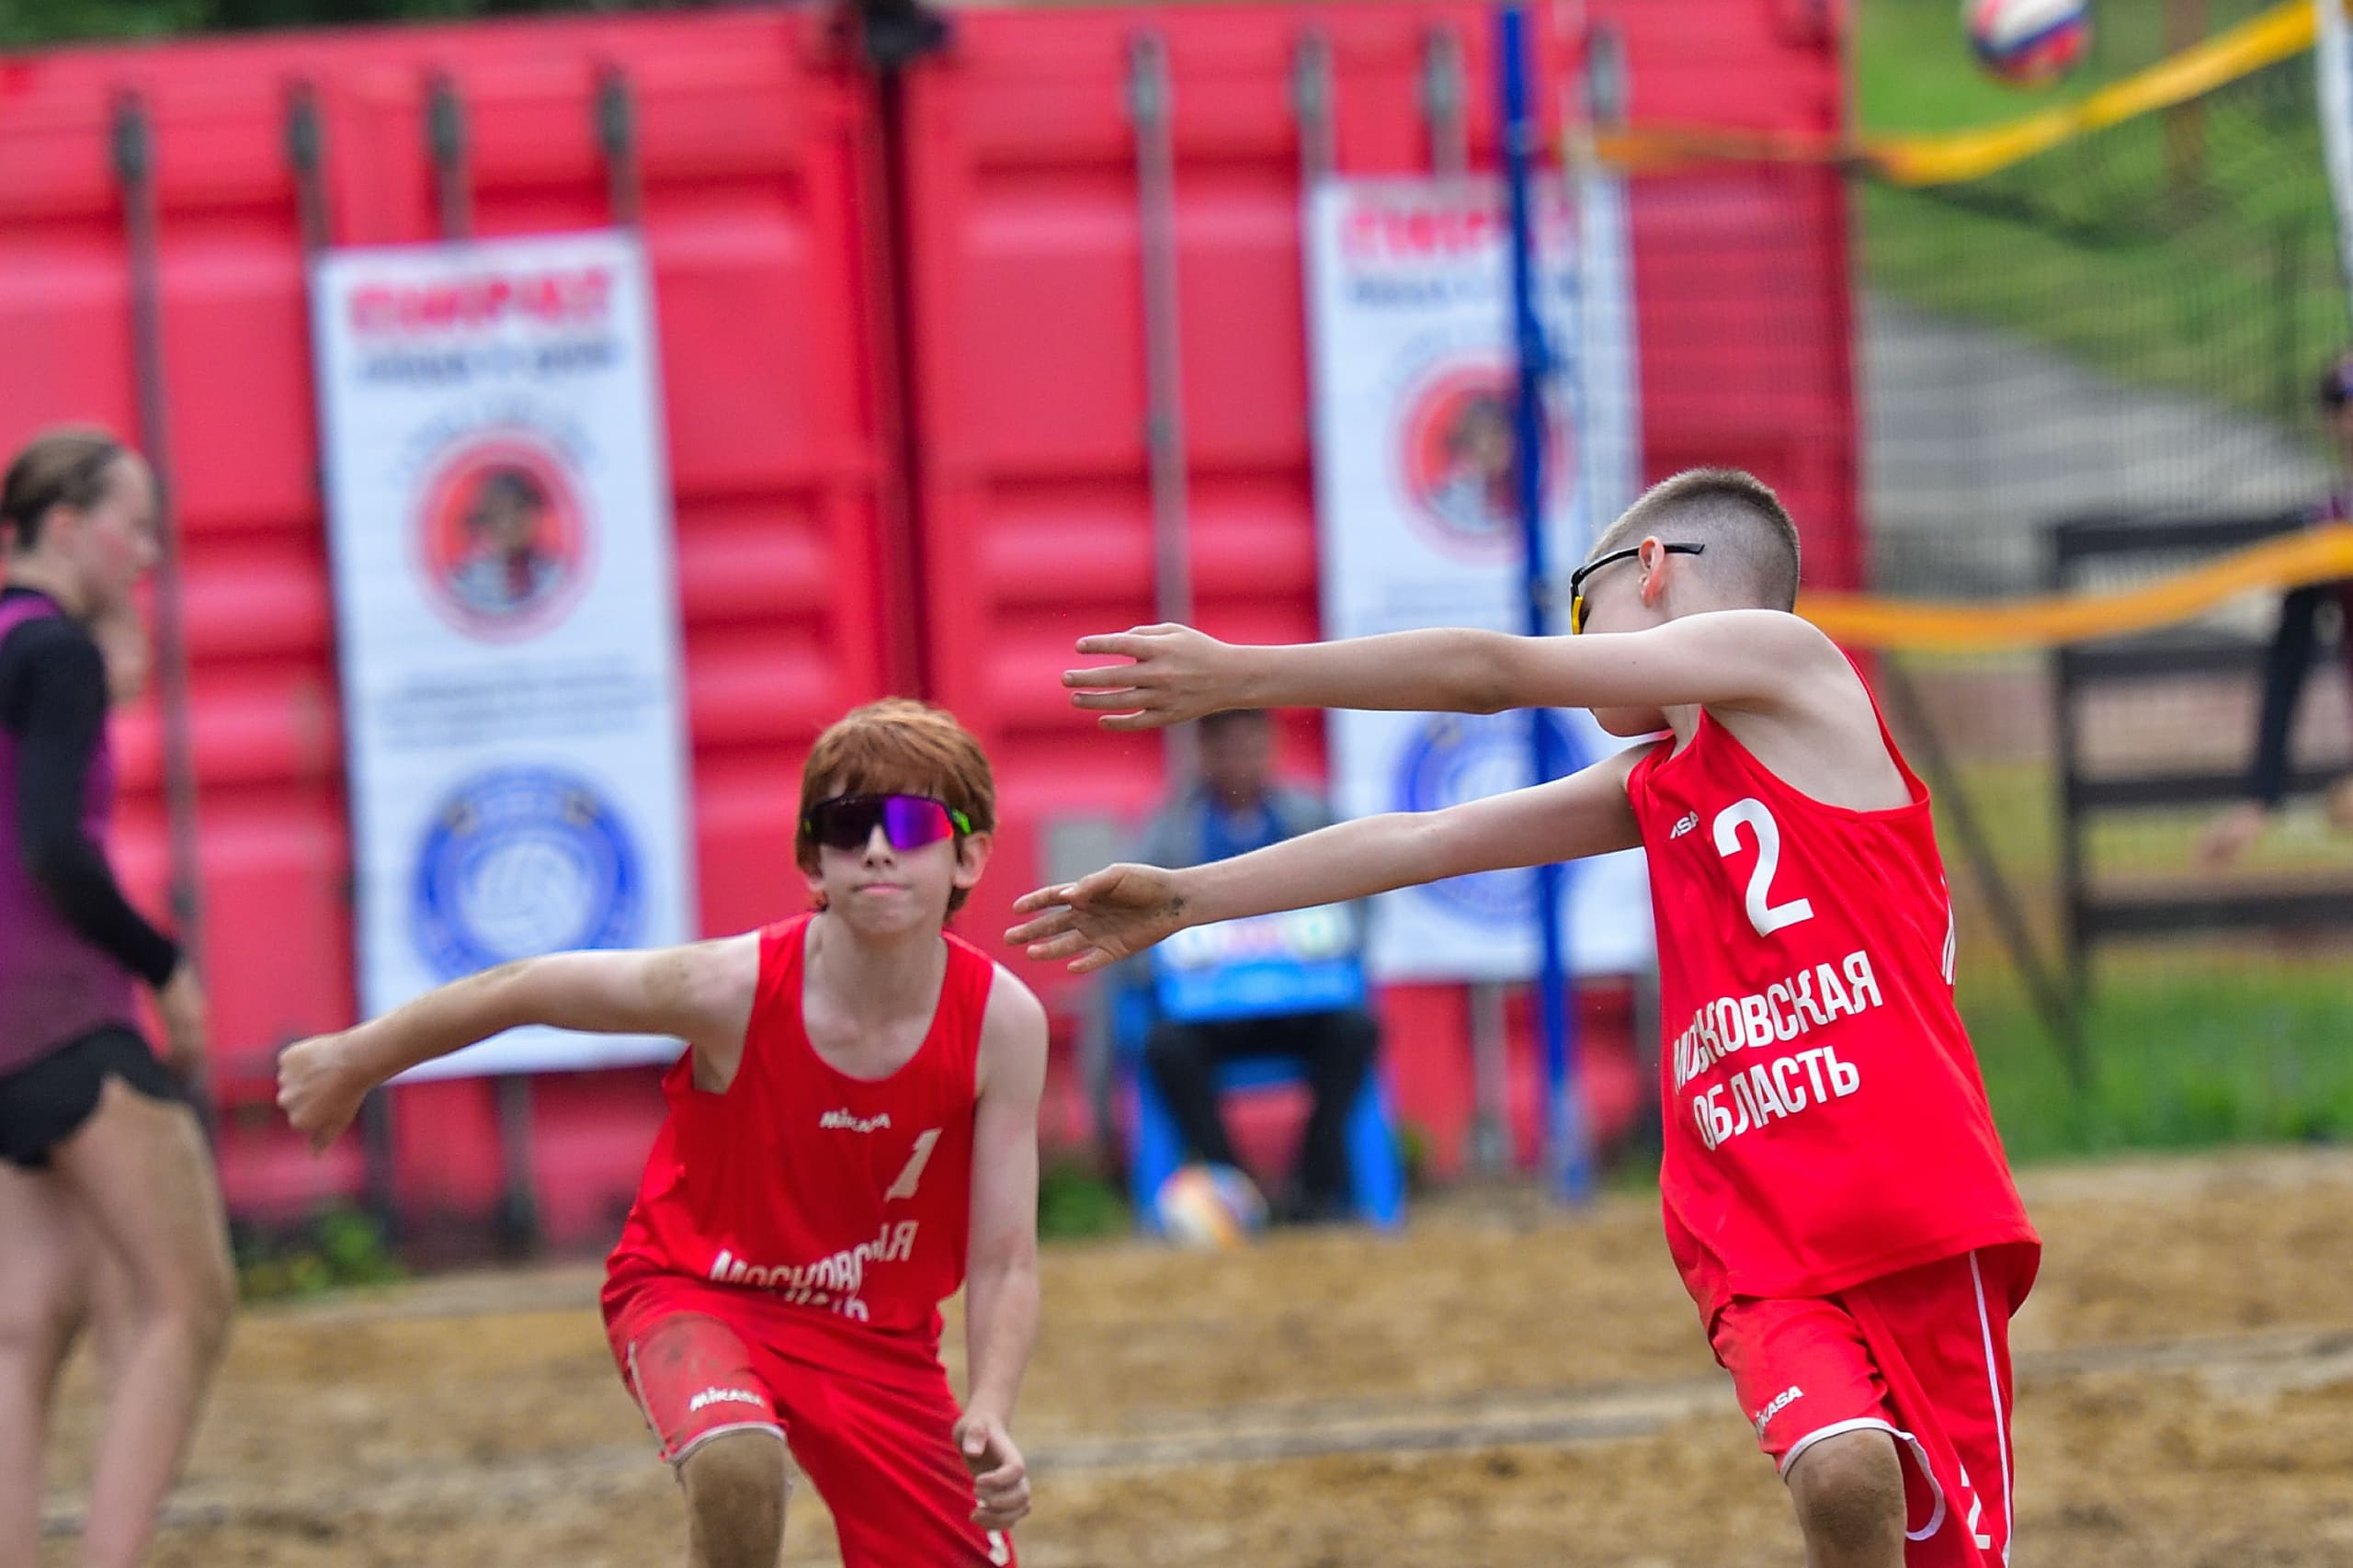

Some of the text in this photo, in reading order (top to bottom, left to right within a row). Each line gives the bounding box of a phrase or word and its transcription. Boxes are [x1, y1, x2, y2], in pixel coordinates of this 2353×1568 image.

[1670, 810, 1699, 839] ASA
[1712, 797, 1814, 937] 2
[1692, 1045, 1860, 1151] ОБЛАСТЬ
[882, 1126, 943, 1203] 1
